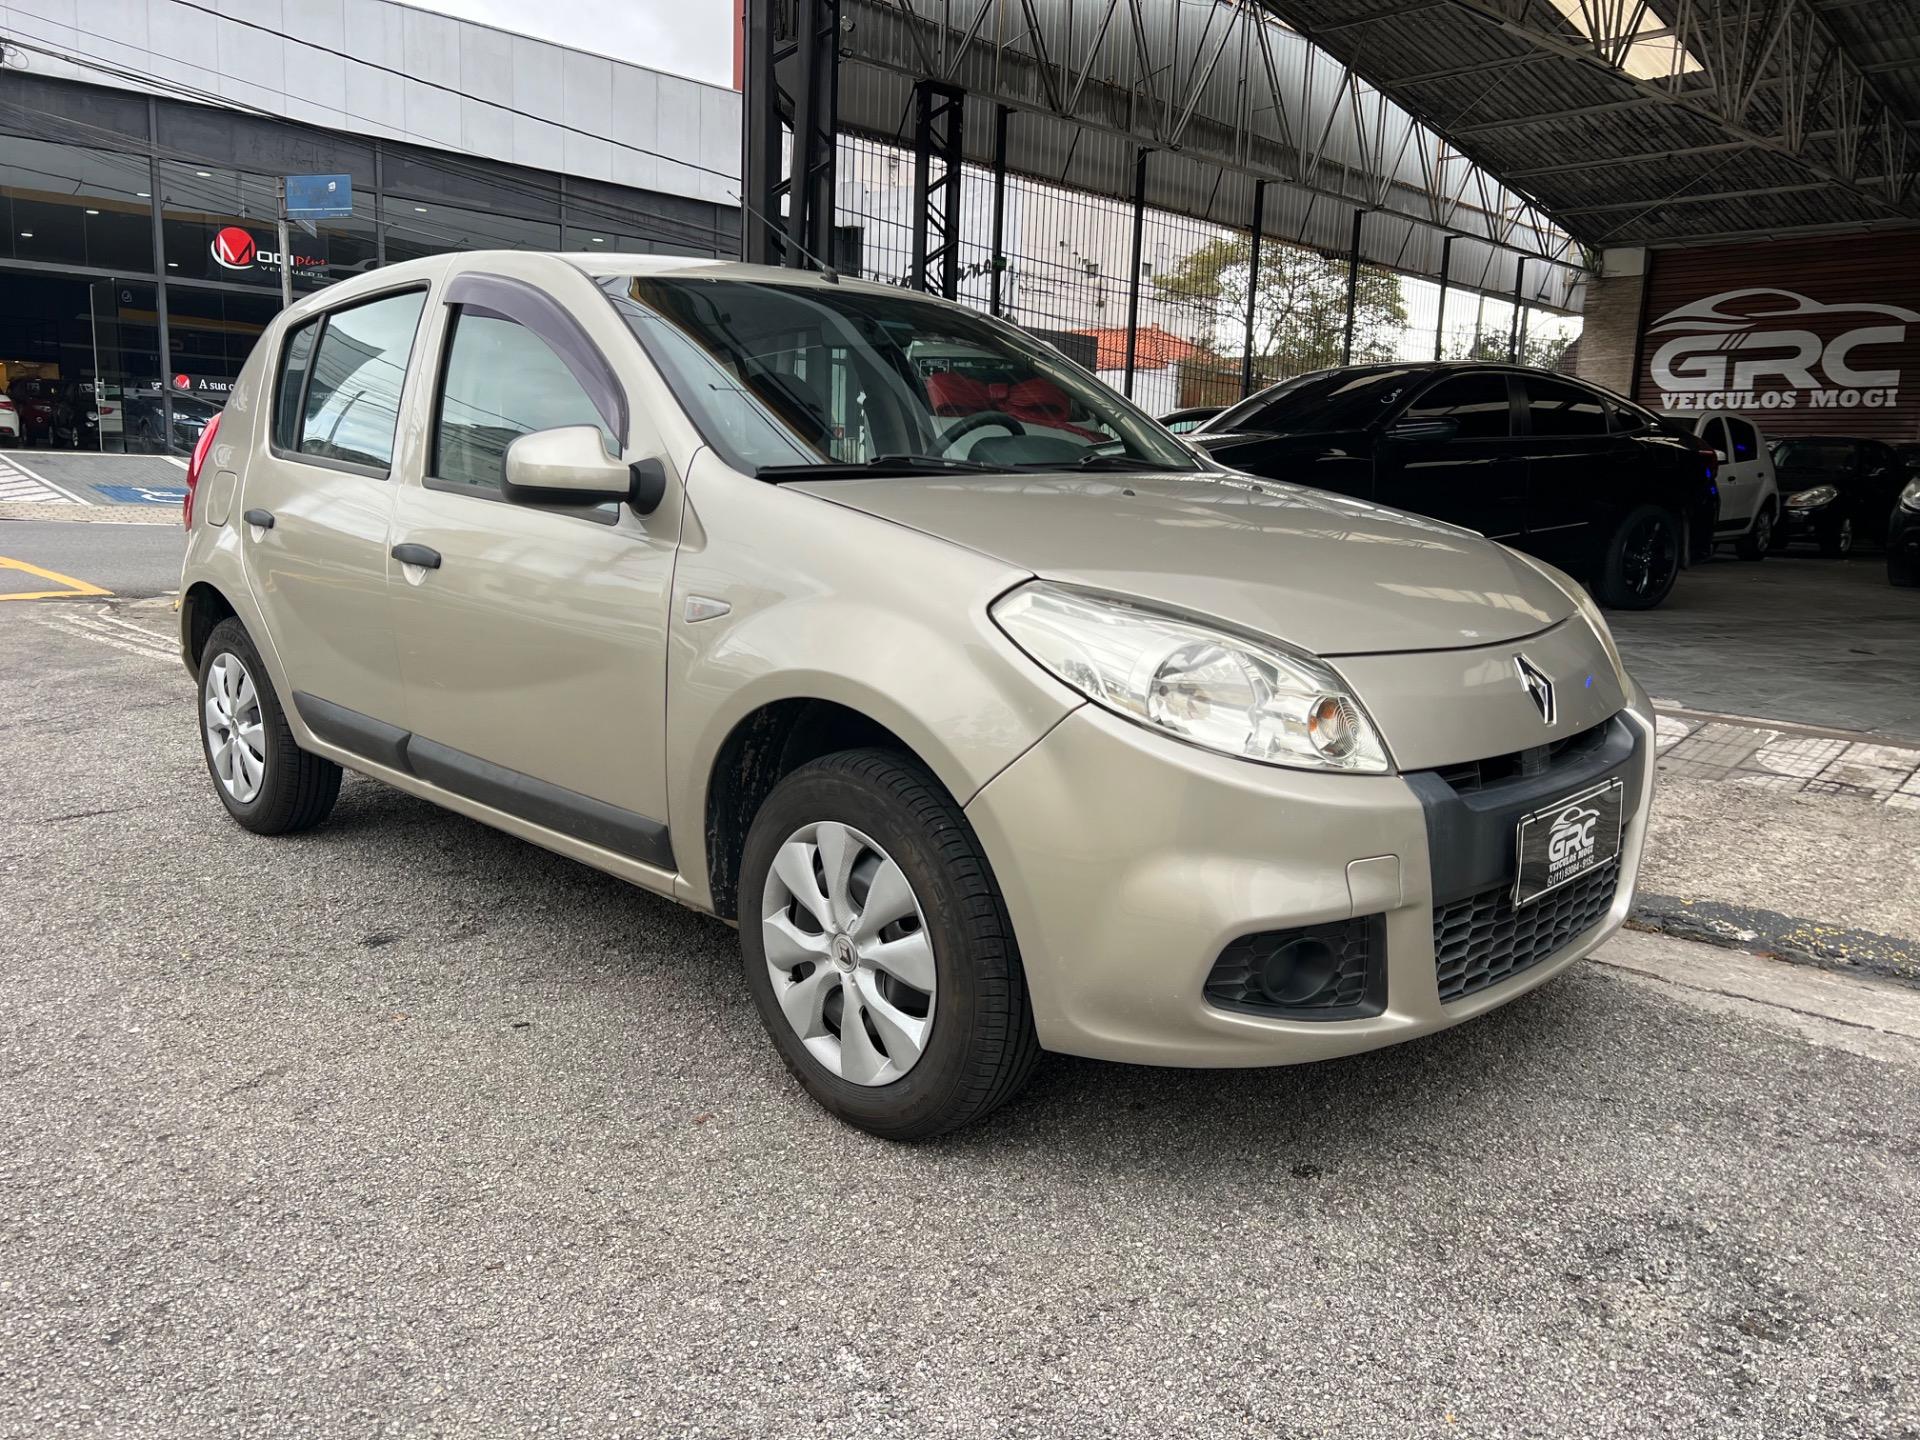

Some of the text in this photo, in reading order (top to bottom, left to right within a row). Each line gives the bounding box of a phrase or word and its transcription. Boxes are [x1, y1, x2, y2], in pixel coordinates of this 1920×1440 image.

[296, 255, 325, 267] Plus
[260, 265, 324, 278] VEIULOS
[1651, 325, 1906, 392] GRC
[198, 379, 208, 390] A
[209, 382, 227, 391] sua
[1660, 389, 1899, 410] VEICULOS MOGI
[1548, 816, 1596, 863] GRC
